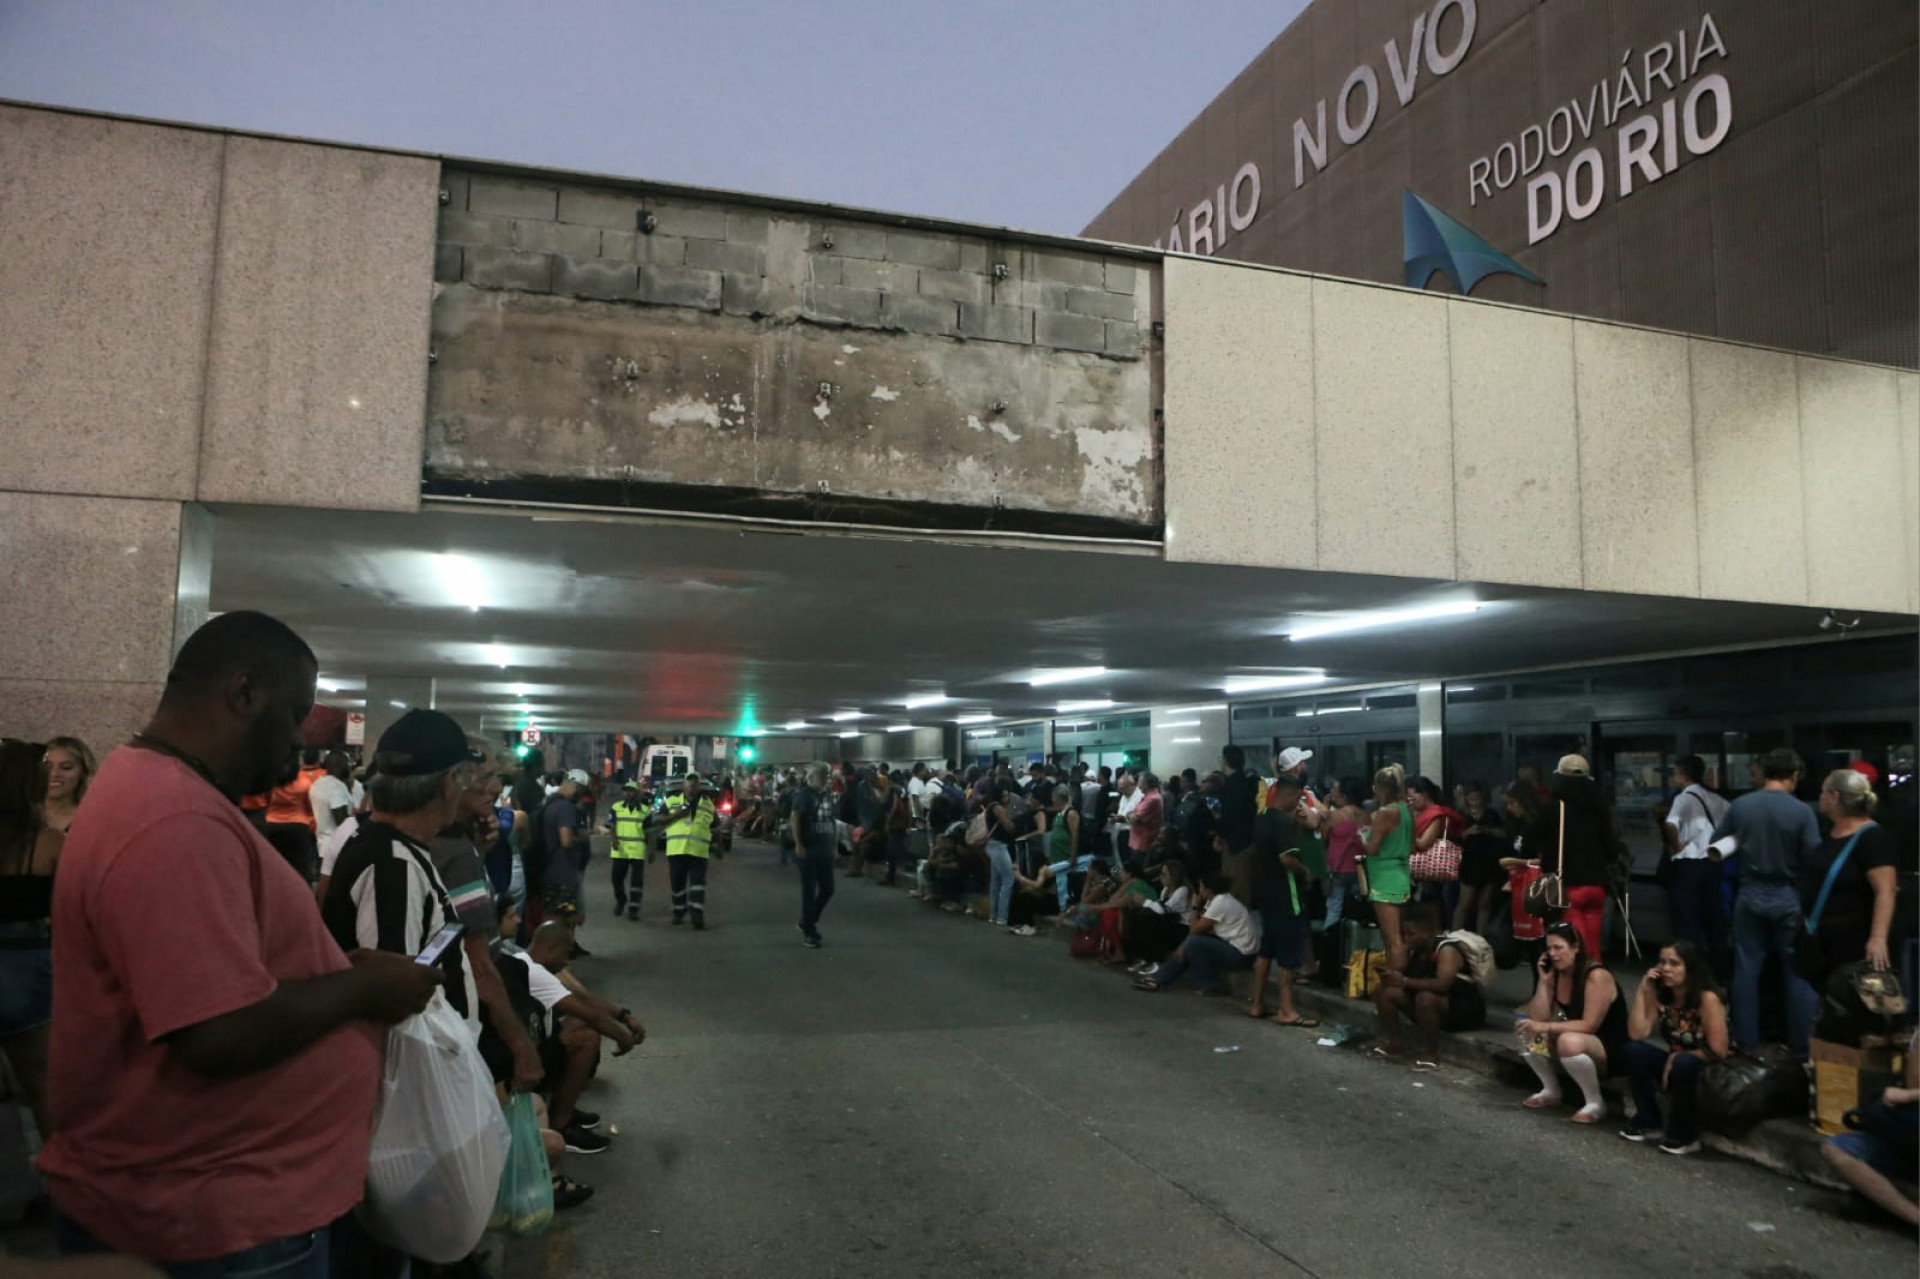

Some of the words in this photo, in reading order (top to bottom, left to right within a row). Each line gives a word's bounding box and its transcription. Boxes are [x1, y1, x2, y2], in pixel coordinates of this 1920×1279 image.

[1293, 0, 1477, 188] NOVO
[1469, 12, 1728, 206] RODOVIÁRIA
[1527, 147, 1604, 245] DO
[1618, 73, 1732, 197] RIO
